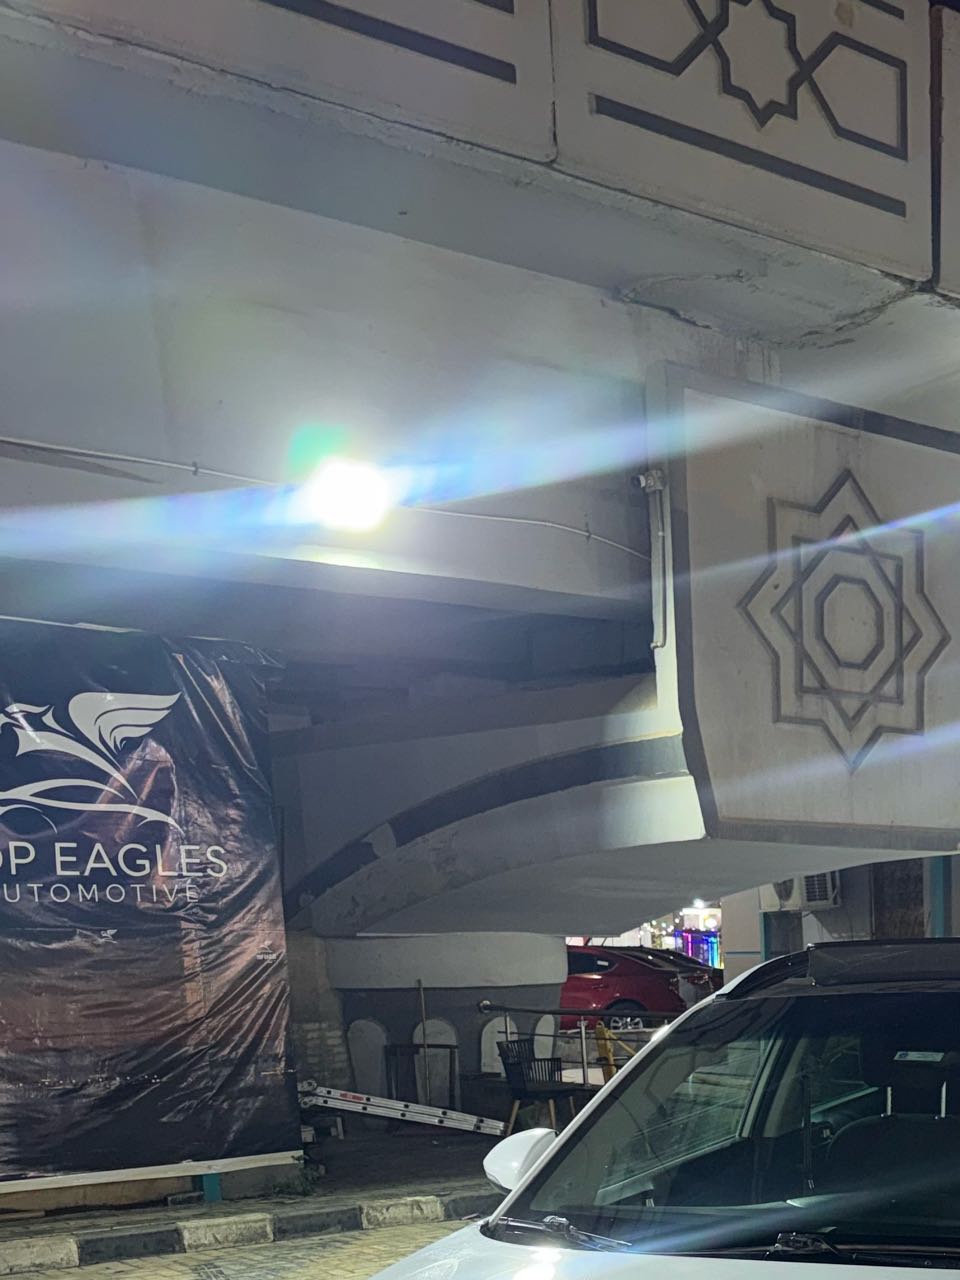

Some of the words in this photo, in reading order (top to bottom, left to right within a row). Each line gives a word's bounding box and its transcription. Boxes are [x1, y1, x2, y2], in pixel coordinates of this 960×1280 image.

[0, 841, 36, 875] P
[54, 842, 228, 877] EAGLES
[3, 883, 199, 903] UTOMOTIVE
